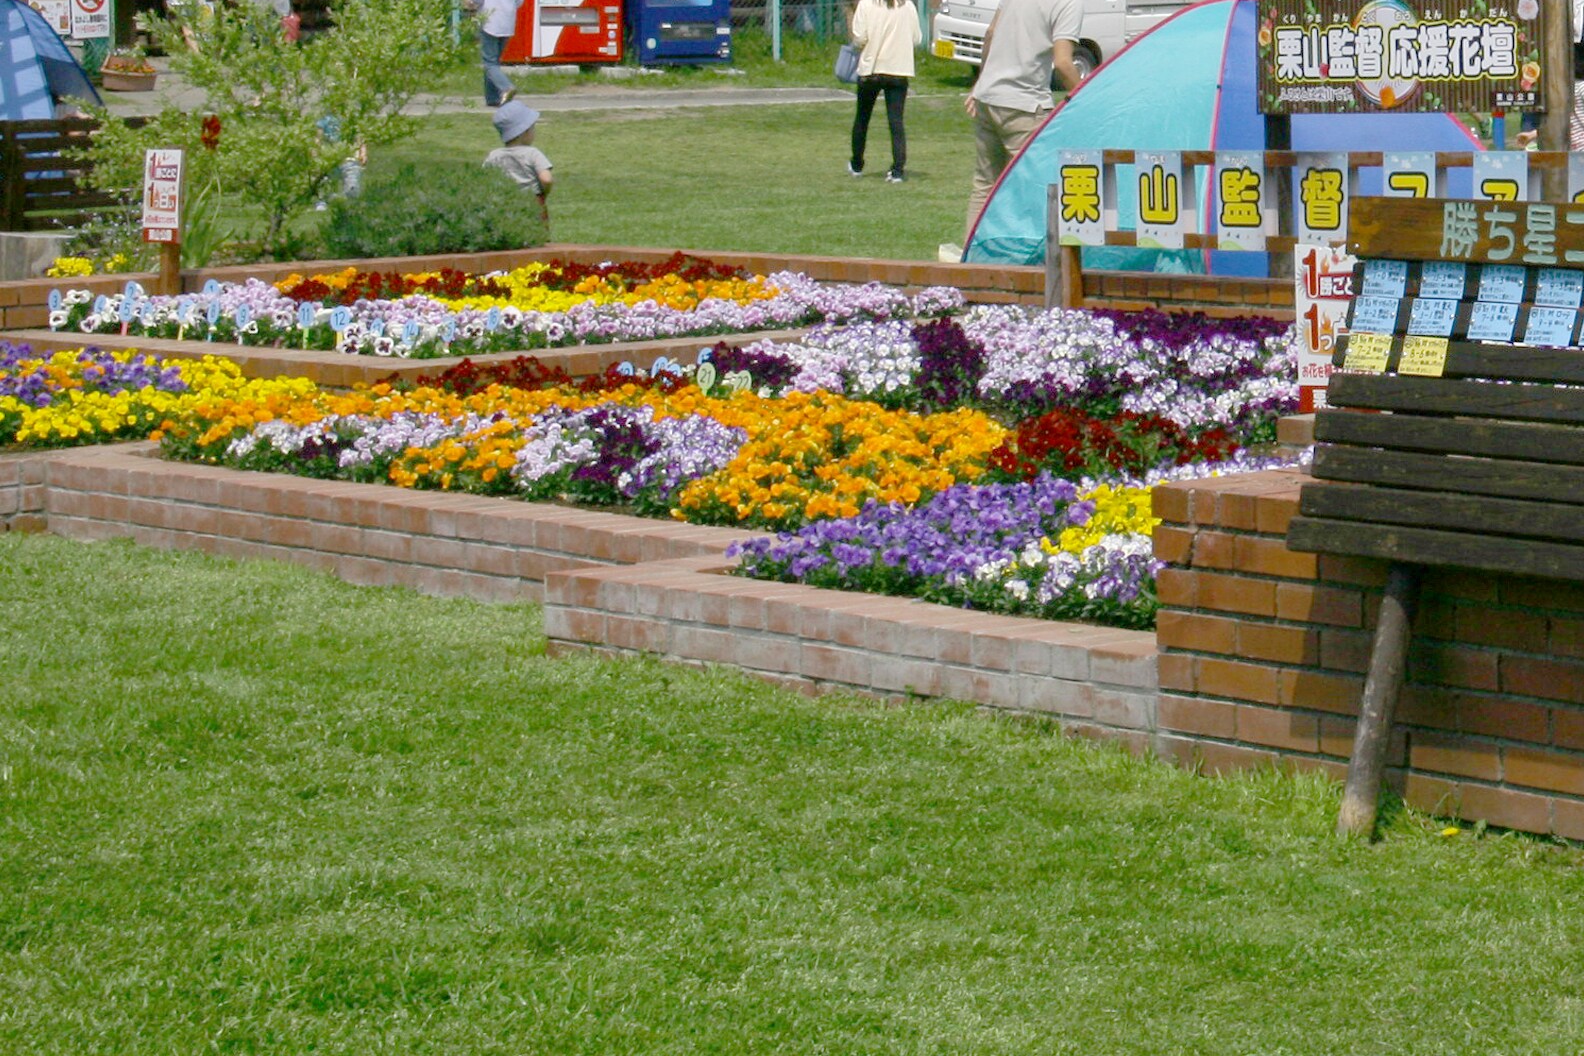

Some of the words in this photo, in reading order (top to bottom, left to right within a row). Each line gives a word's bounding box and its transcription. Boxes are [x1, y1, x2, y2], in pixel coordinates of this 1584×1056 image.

[1276, 26, 1384, 80] 栗山監督
[1388, 20, 1516, 78] 応援花壇
[334, 312, 346, 326] 12
[700, 368, 712, 383] 21
